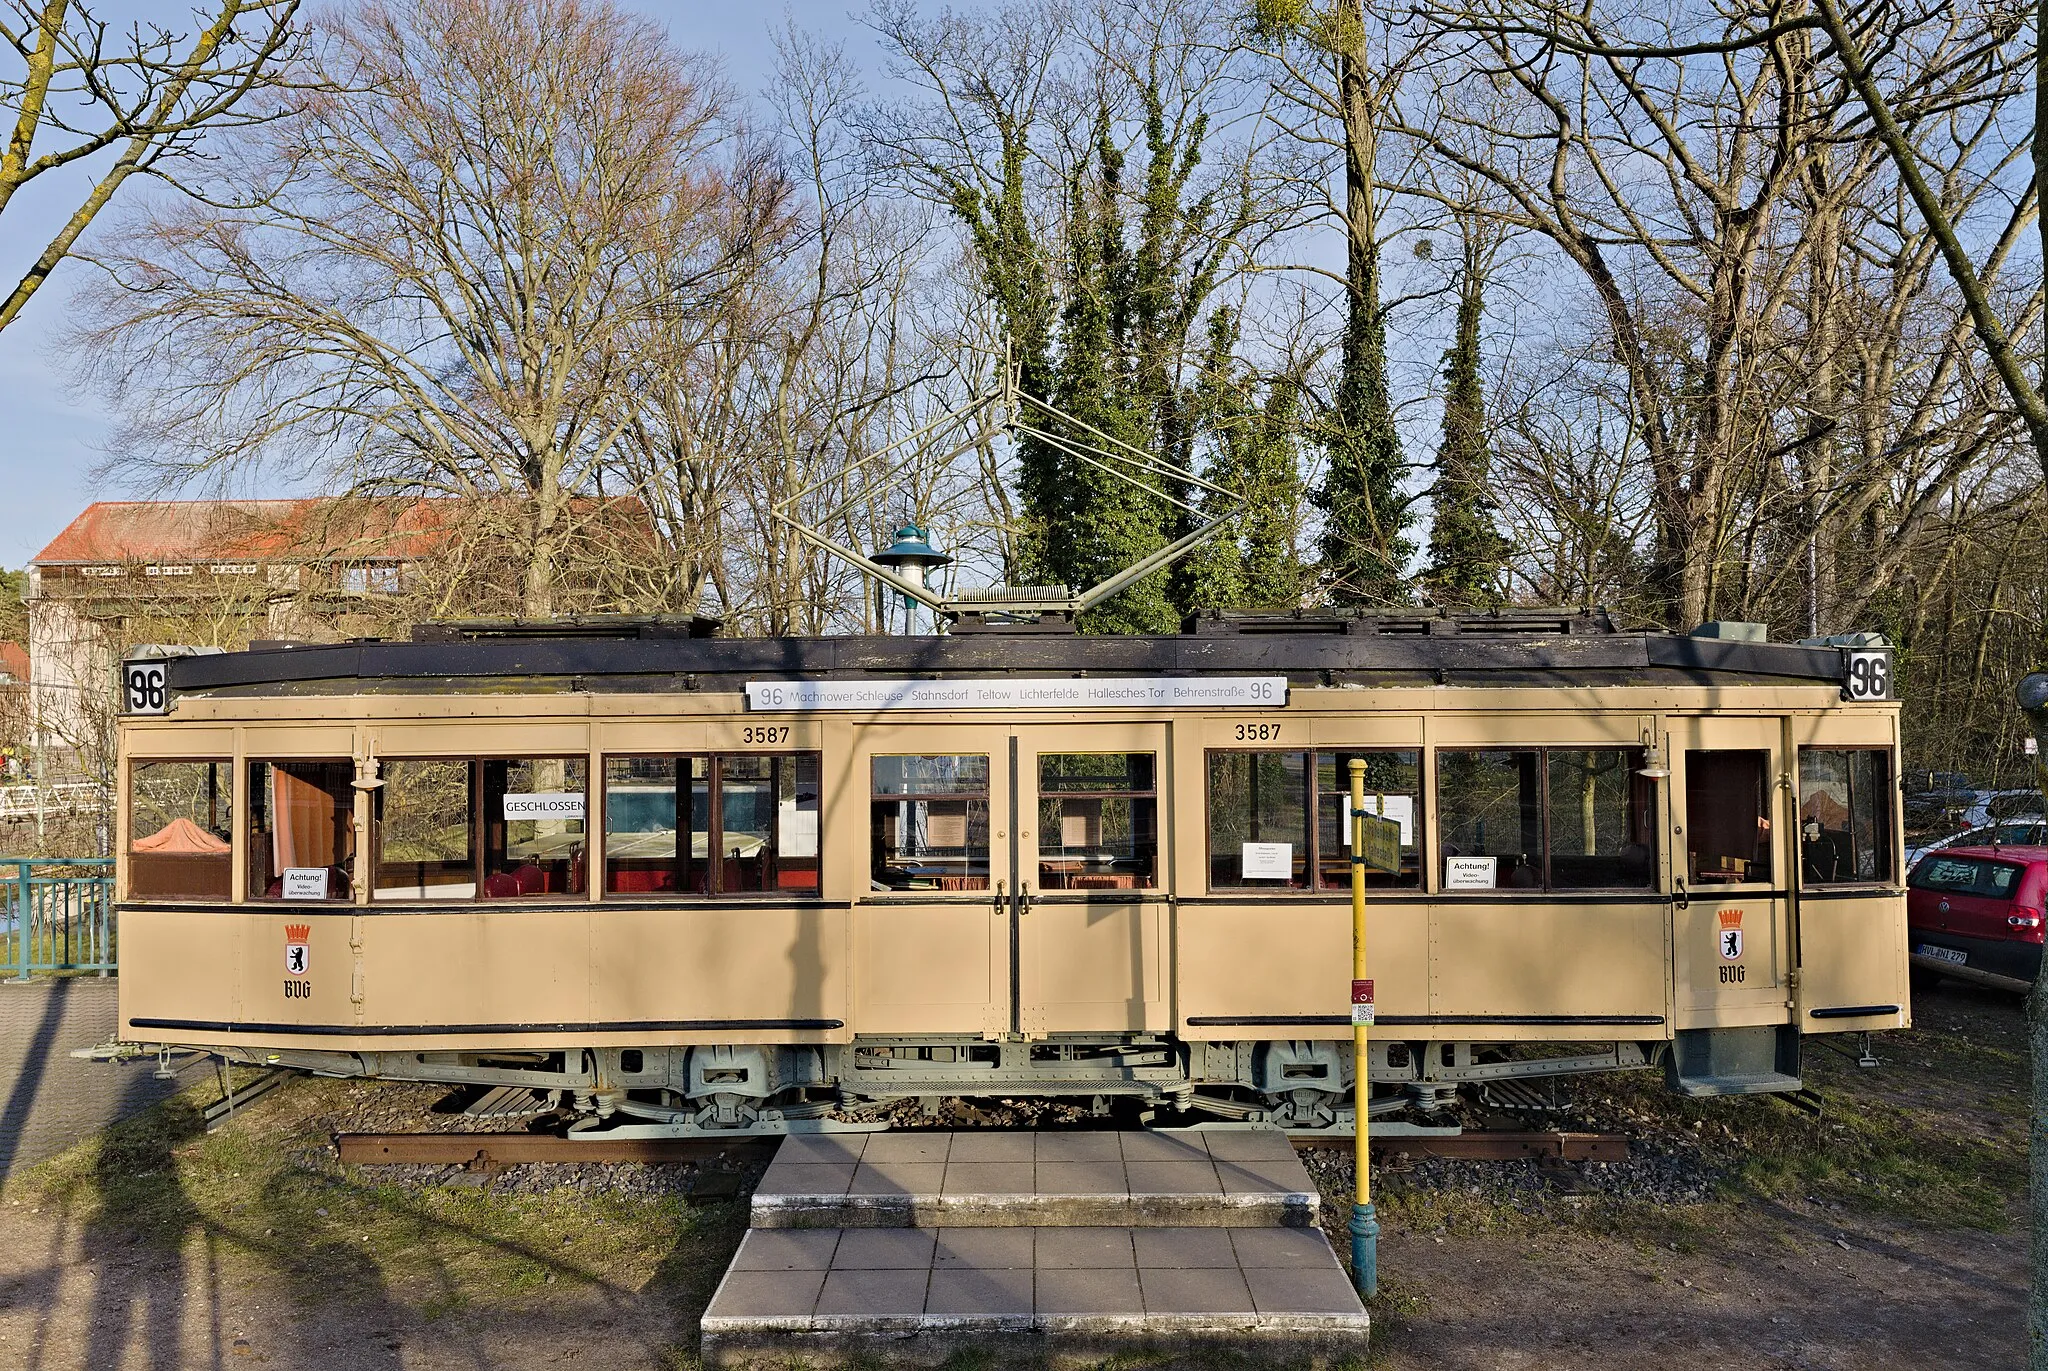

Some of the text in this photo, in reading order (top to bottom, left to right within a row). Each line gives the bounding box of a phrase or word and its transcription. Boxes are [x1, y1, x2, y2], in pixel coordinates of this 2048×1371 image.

[1852, 657, 1885, 697] 96
[130, 670, 163, 710] 96
[761, 682, 1273, 706] 96 Machnower Schleuse Stahnsdorf Teltow Lichterfelde Hallesches Tor Behrenstraße 96
[743, 727, 789, 744] 3587
[1235, 724, 1281, 741] 3587
[506, 801, 586, 812] GESCHLOSSEN
[1454, 862, 1490, 871] Achtung!
[289, 873, 322, 882] Achtung!
